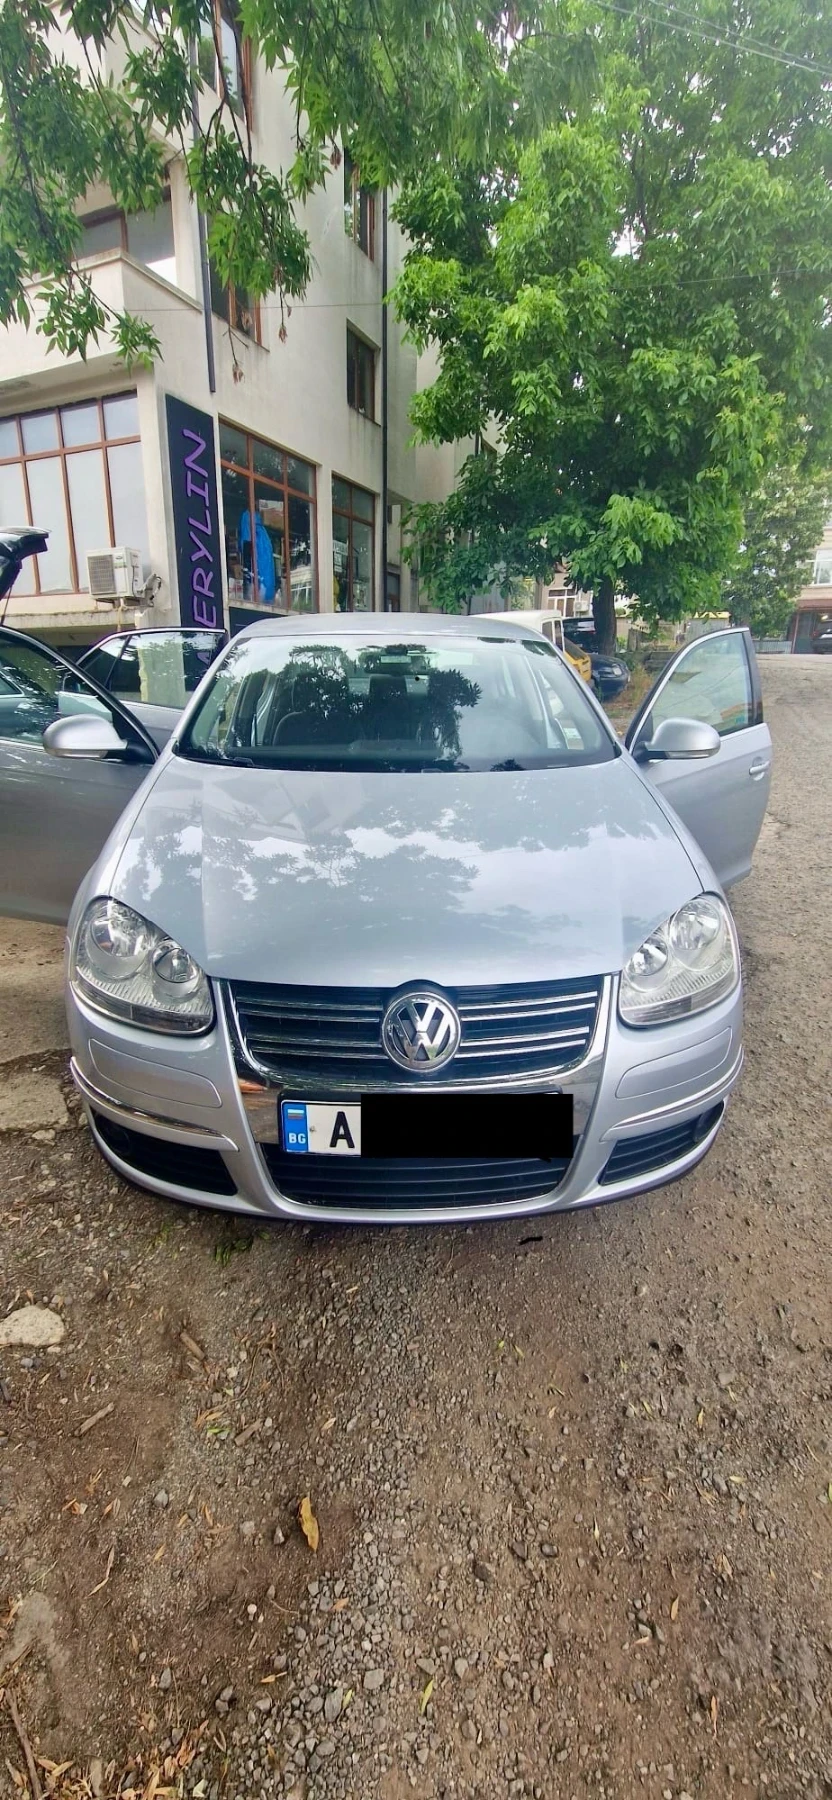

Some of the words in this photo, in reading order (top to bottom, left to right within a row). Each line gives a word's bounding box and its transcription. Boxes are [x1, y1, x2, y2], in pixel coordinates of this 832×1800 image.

[389, 997, 454, 1063] VW
[288, 1132, 306, 1144] BG
[329, 1111, 355, 1149] A
